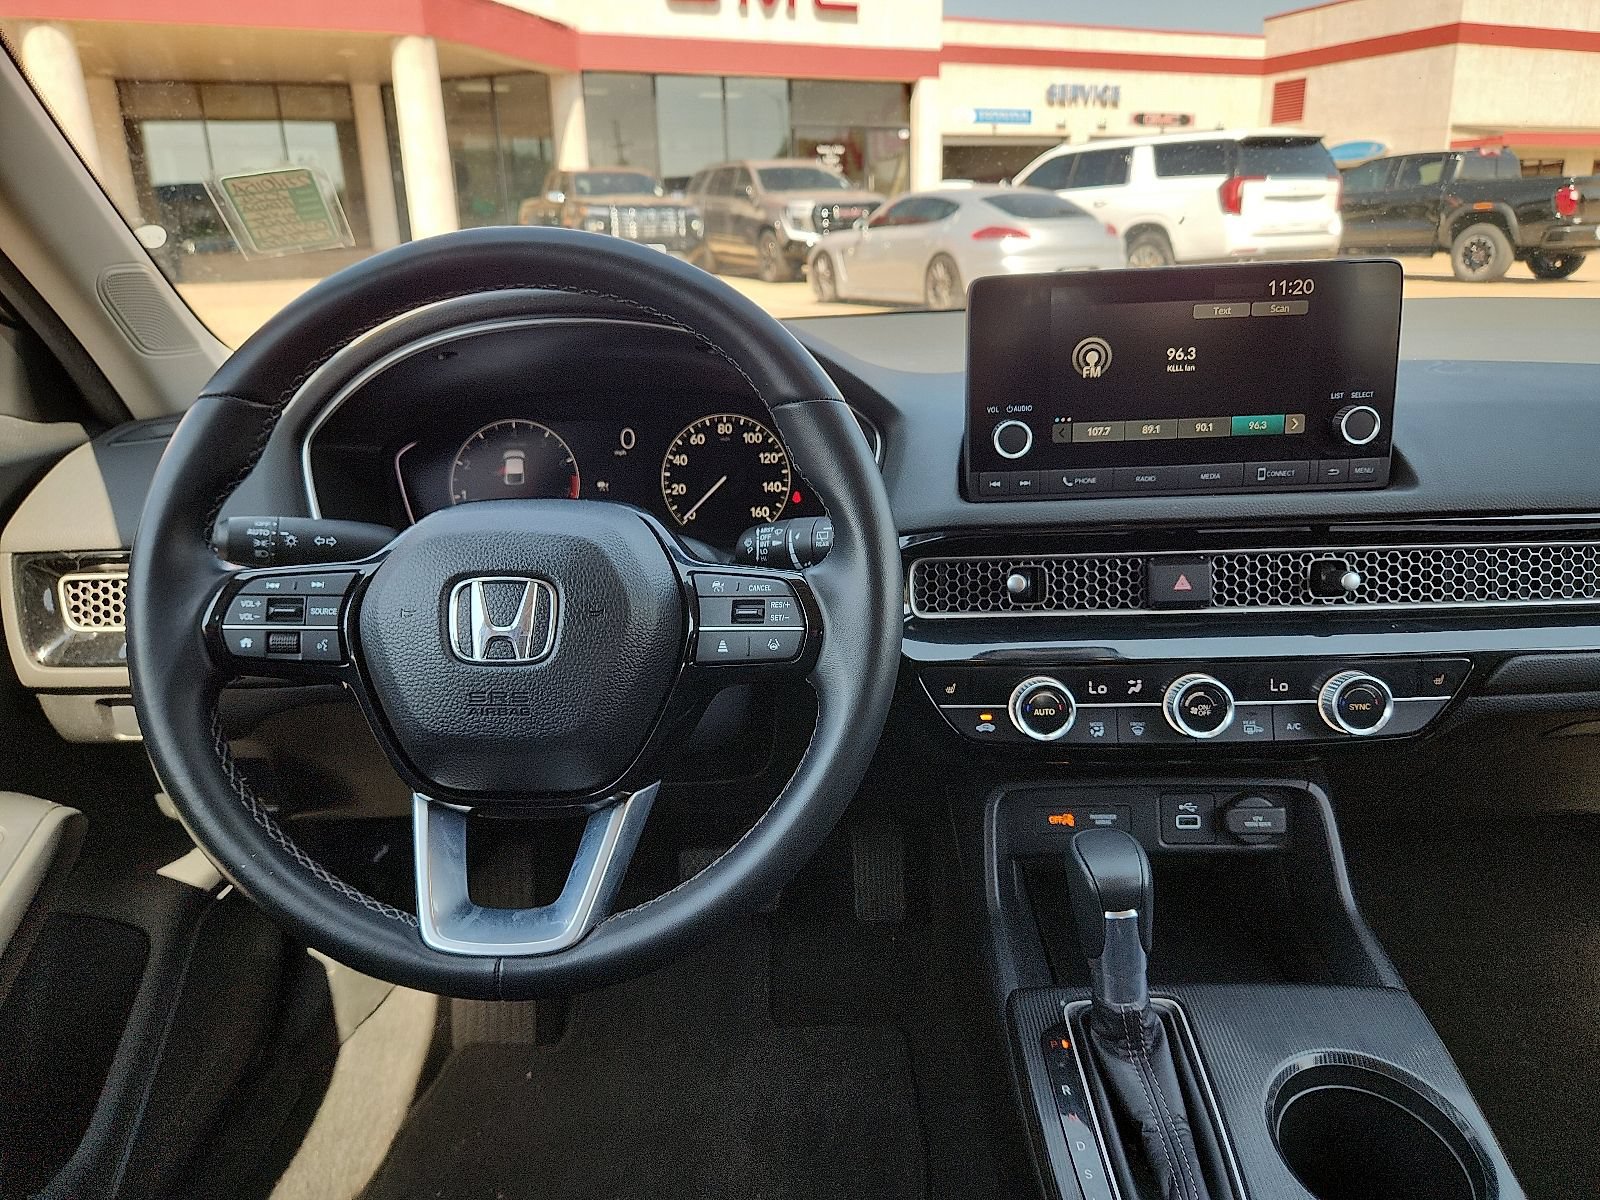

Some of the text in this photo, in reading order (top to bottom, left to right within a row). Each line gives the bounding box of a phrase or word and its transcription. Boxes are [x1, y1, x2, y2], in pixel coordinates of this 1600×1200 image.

[1047, 84, 1120, 108] SERVICE
[1268, 279, 1315, 295] 11:20
[1213, 306, 1232, 315] Text
[1270, 304, 1290, 313] Scan
[1166, 346, 1197, 361] 96.3
[1082, 366, 1101, 378] FM
[1330, 391, 1374, 400] LIST SELECT
[717, 423, 733, 435] 80
[1141, 425, 1161, 434] 89.1
[1195, 423, 1213, 432] 90.1
[1248, 421, 1267, 430] 96.3
[1087, 427, 1111, 437] 107.7
[619, 427, 636, 450] 0
[689, 433, 705, 445] 60
[743, 432, 762, 444] 100
[672, 454, 688, 466] 40
[759, 452, 779, 464] 120
[1266, 470, 1295, 478] CONNECT
[1074, 477, 1097, 485] PHONE
[671, 483, 687, 495] 20
[762, 481, 782, 493] 140
[750, 506, 770, 518] 160
[748, 584, 771, 592] CANCEL
[310, 607, 338, 615] SOURCE
[1088, 681, 1108, 694] Lo
[1269, 679, 1289, 692] Lo
[468, 691, 530, 706] SRS
[1033, 708, 1056, 716] AUTO
[1349, 703, 1372, 711] SYNC
[1286, 722, 1302, 730] A/C
[1048, 815, 1063, 824] OFF
[1061, 1084, 1072, 1096] R
[1076, 1141, 1086, 1151] D
[1084, 1169, 1093, 1180] S
